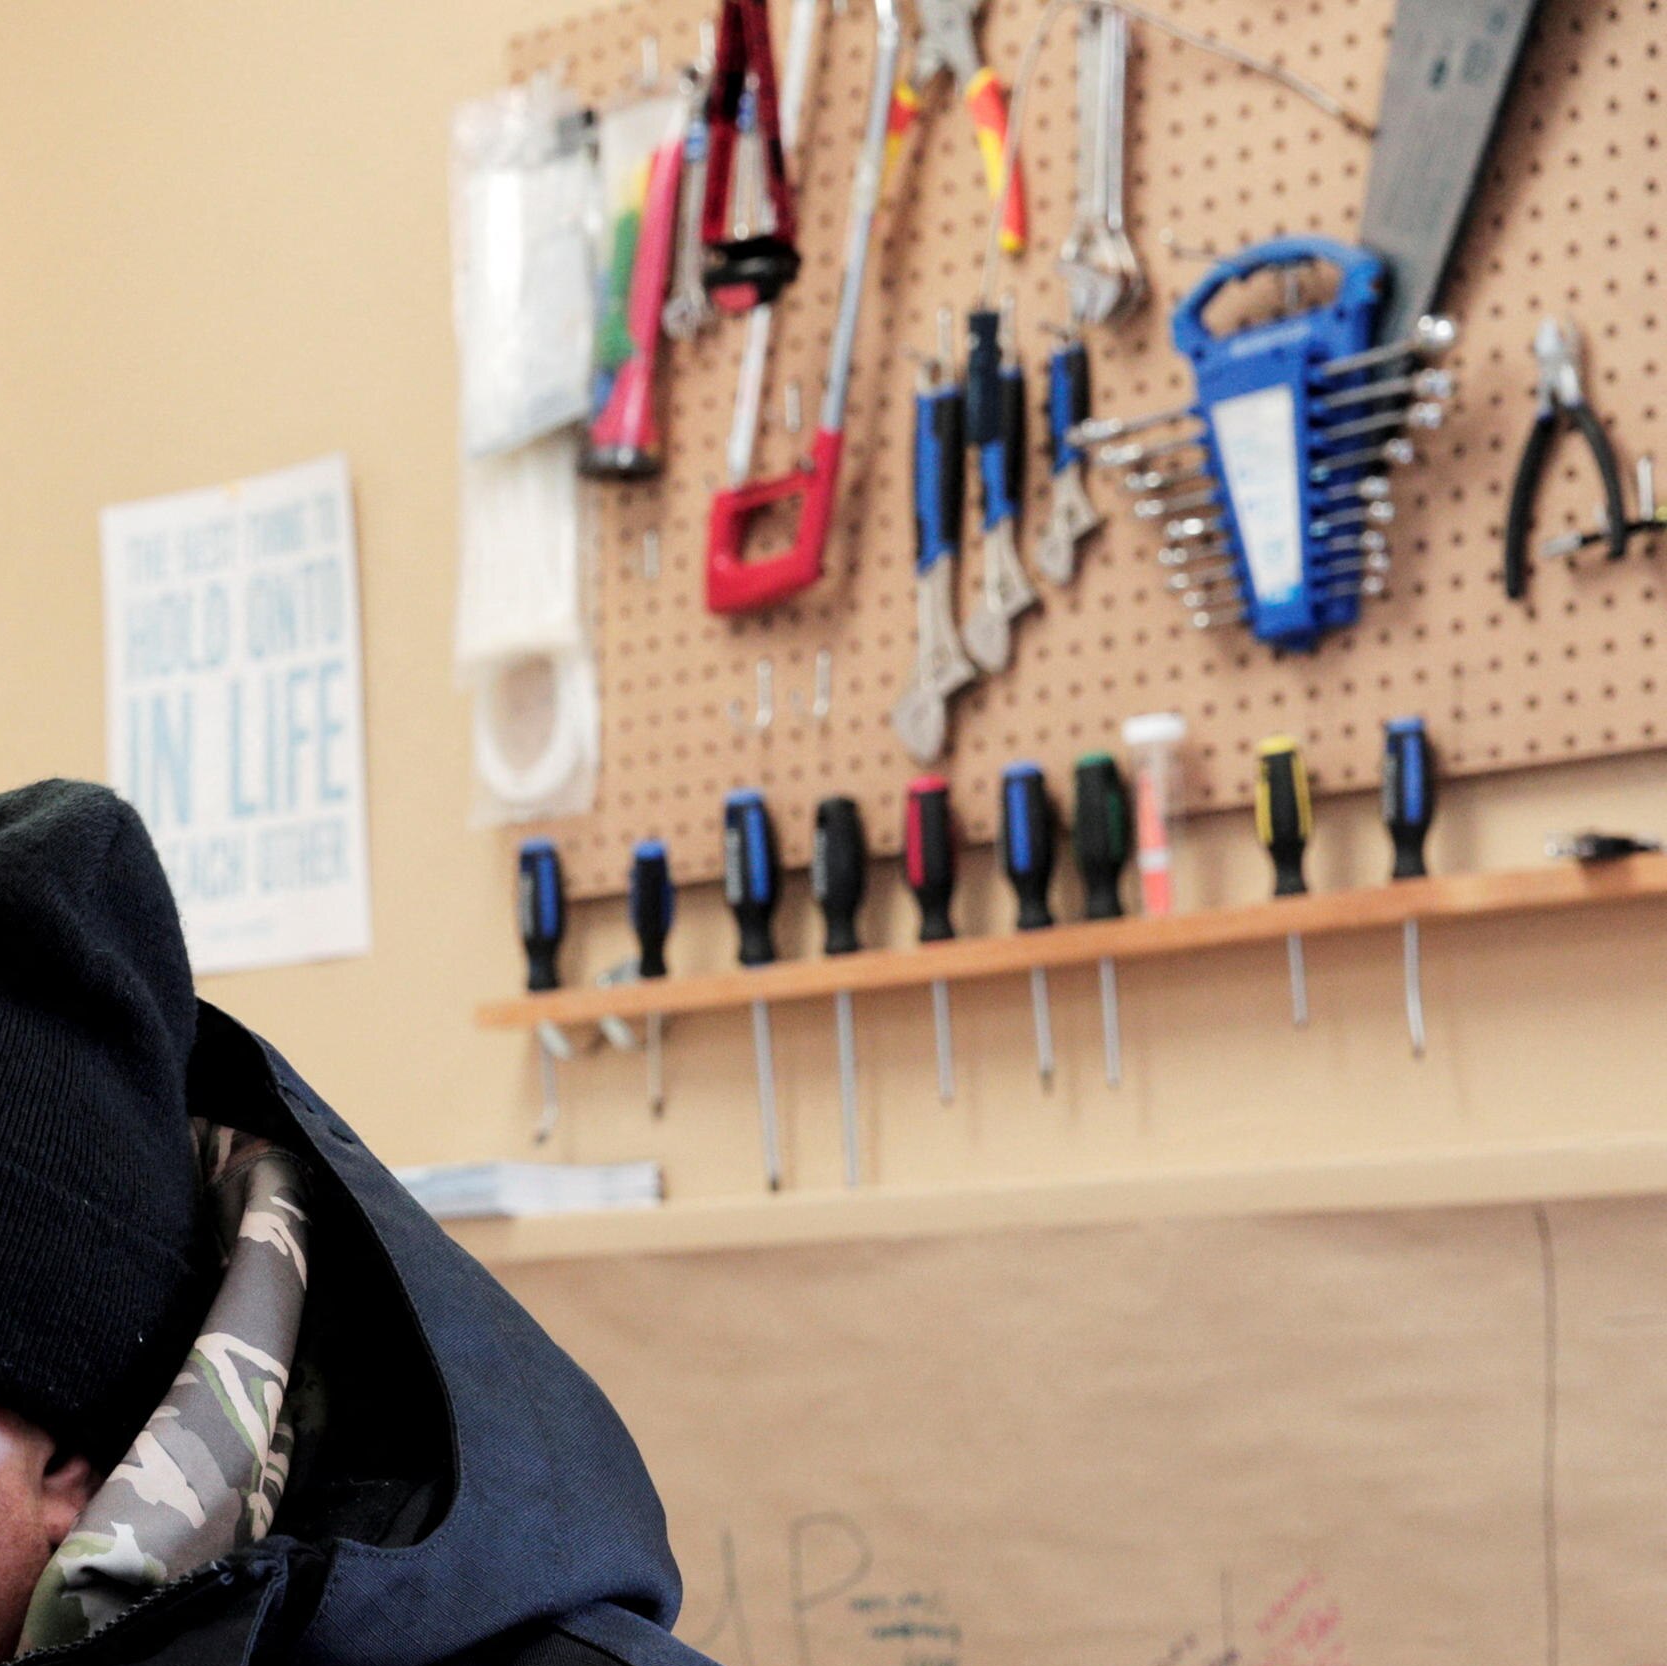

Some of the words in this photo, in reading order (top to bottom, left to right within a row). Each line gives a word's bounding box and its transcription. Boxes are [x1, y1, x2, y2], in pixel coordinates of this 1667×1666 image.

[124, 583, 229, 682] HOLD
[246, 558, 343, 660] ONTO
[126, 687, 194, 828] IN
[229, 659, 346, 818] LIFE
